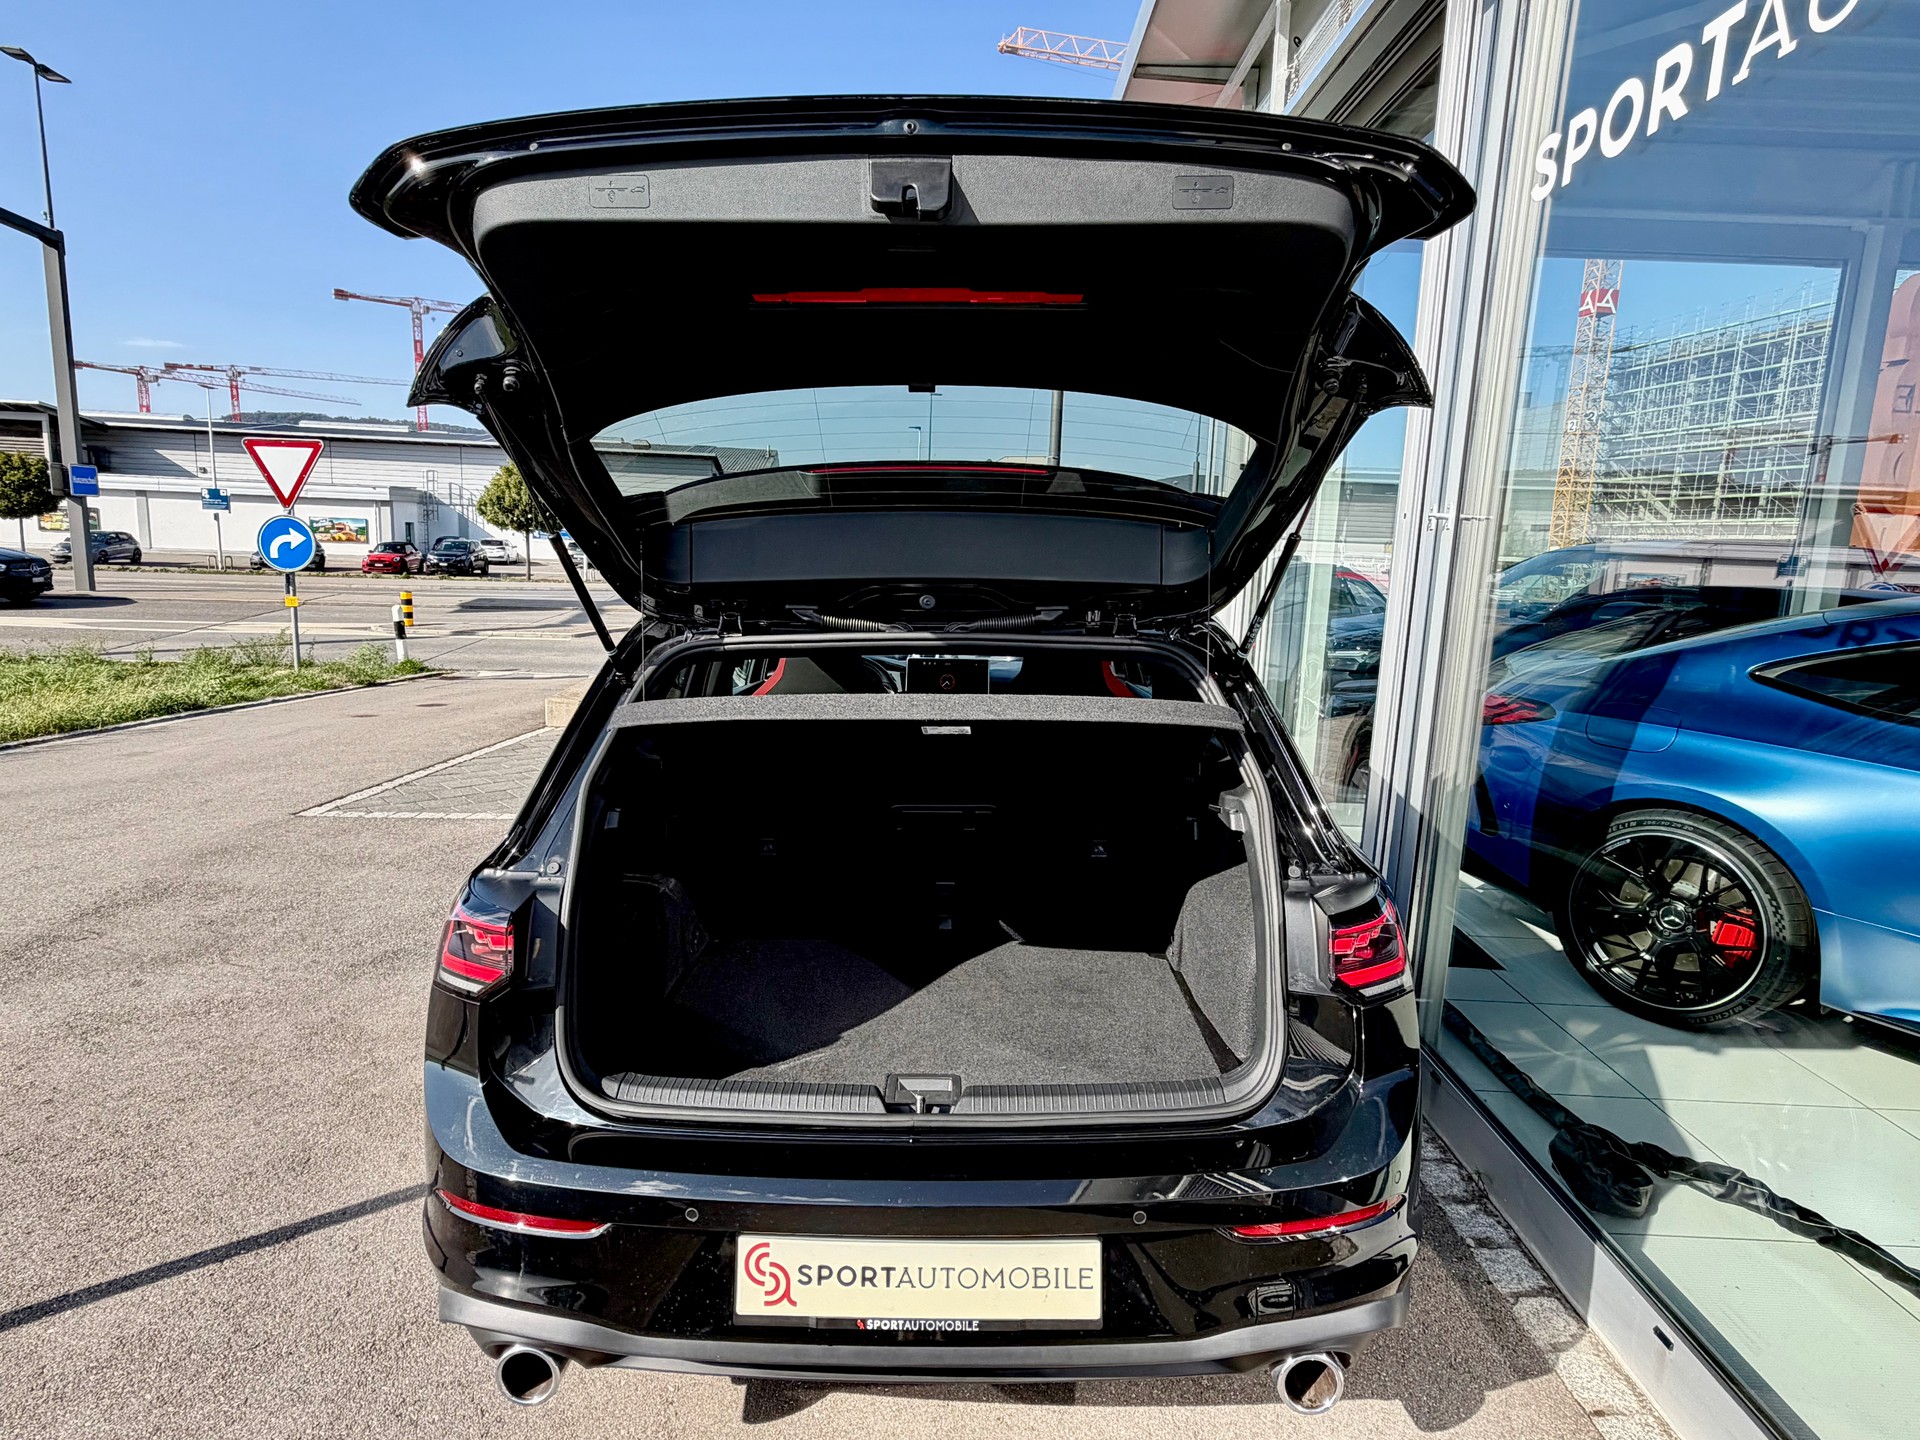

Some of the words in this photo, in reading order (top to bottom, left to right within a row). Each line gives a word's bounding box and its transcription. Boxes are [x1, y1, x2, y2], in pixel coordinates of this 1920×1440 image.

[1687, 1005, 1744, 1024] MICHELIN
[797, 1264, 1094, 1290] SPORTAUTOMOBILE
[866, 1319, 979, 1331] SPORTAUTOMOBILE
